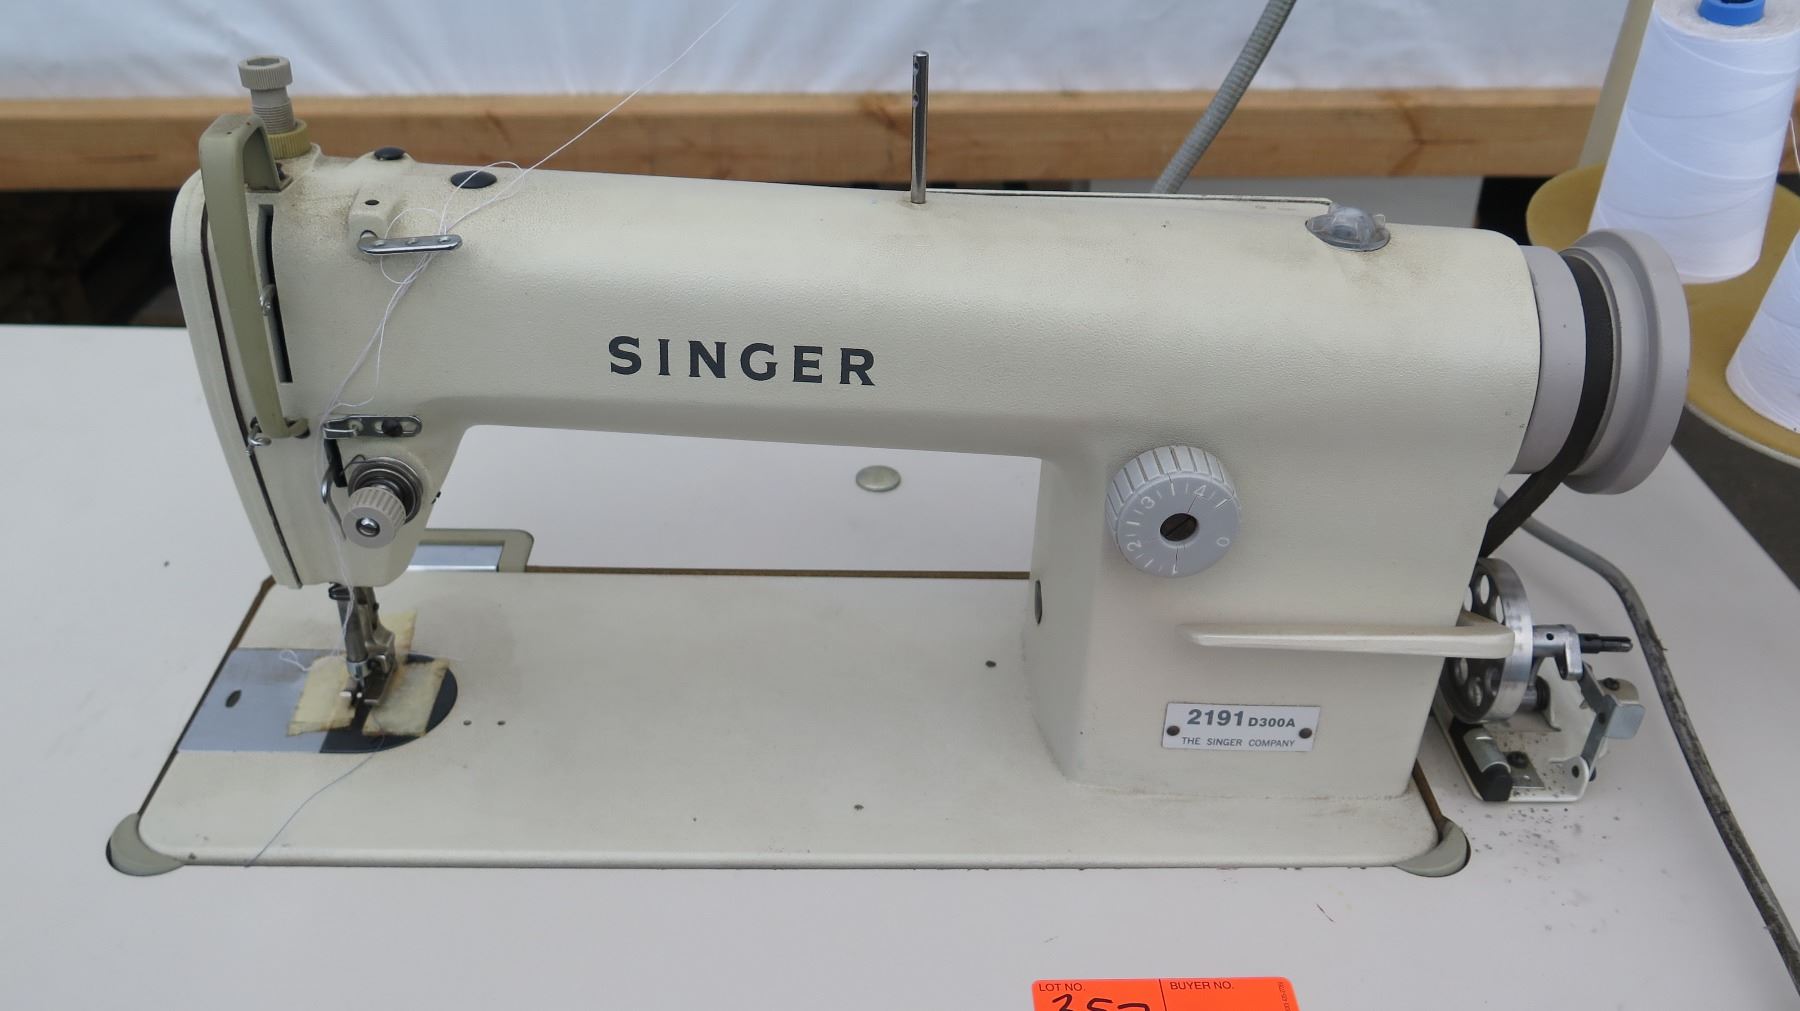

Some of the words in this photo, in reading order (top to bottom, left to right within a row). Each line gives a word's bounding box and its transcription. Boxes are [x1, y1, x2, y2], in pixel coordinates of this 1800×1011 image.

[609, 336, 876, 387] SINGER
[1194, 485, 1206, 497] 4
[1141, 496, 1155, 509] 3
[1127, 540, 1142, 551] 2
[1216, 537, 1230, 547] 0
[1187, 709, 1244, 726] 2191
[1248, 717, 1295, 728] D300A
[1182, 737, 1200, 745] THE
[1206, 737, 1243, 746] SINGER
[1248, 739, 1295, 748] COMPANY
[1039, 983, 1061, 992] LOT
[1065, 982, 1086, 992] NO.
[1170, 981, 1211, 990] BUYER
[1215, 981, 1234, 990] NO.
